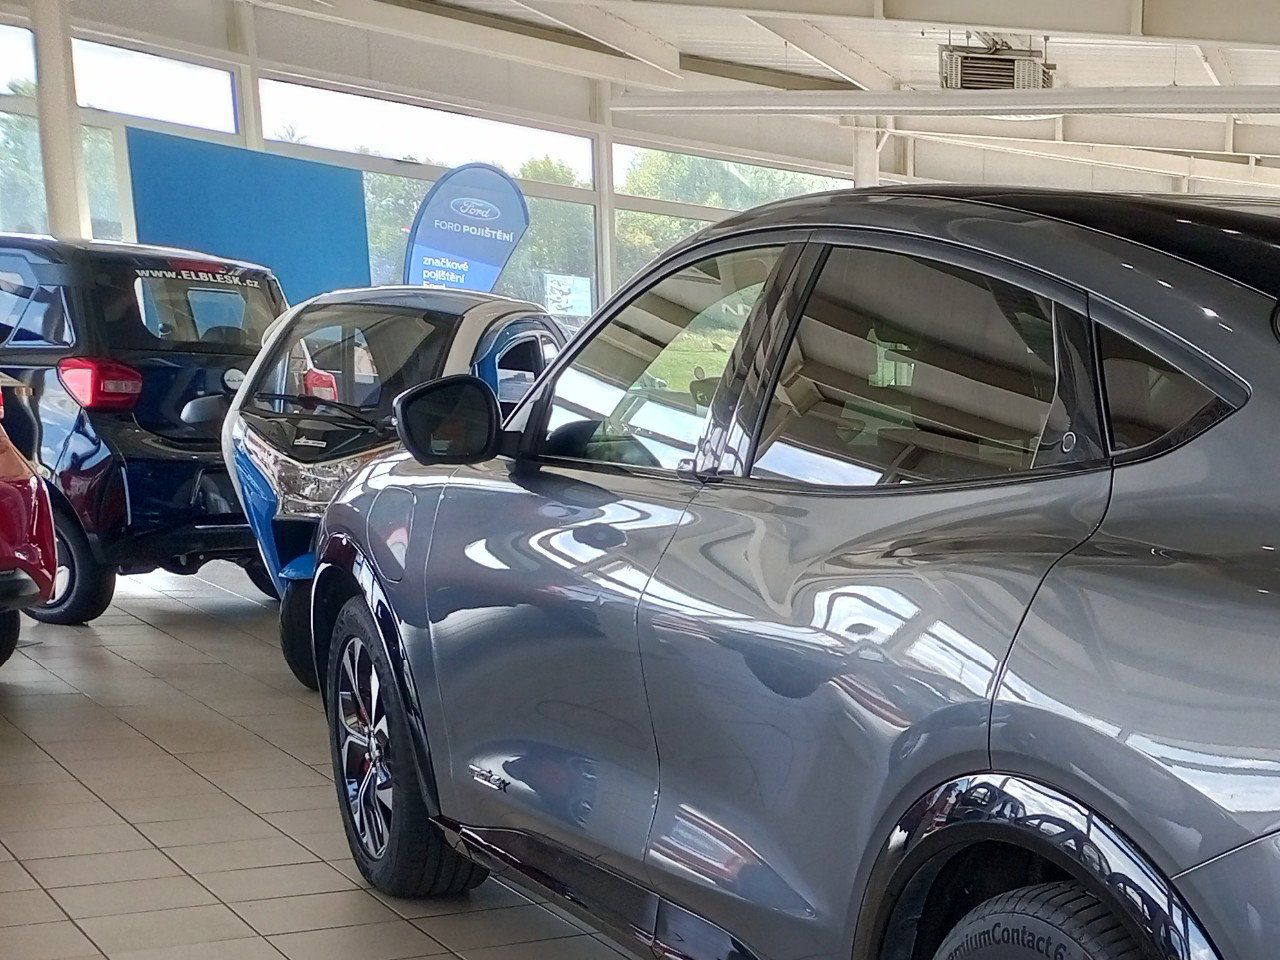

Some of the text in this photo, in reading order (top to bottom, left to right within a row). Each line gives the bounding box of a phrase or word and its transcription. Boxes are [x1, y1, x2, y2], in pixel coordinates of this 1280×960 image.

[457, 199, 494, 218] Ford
[434, 220, 514, 242] FORD POJIŠTĚNÍ
[422, 256, 469, 272] značkové
[134, 269, 260, 288] www.ELBLESK.cz
[422, 269, 466, 284] pojištění
